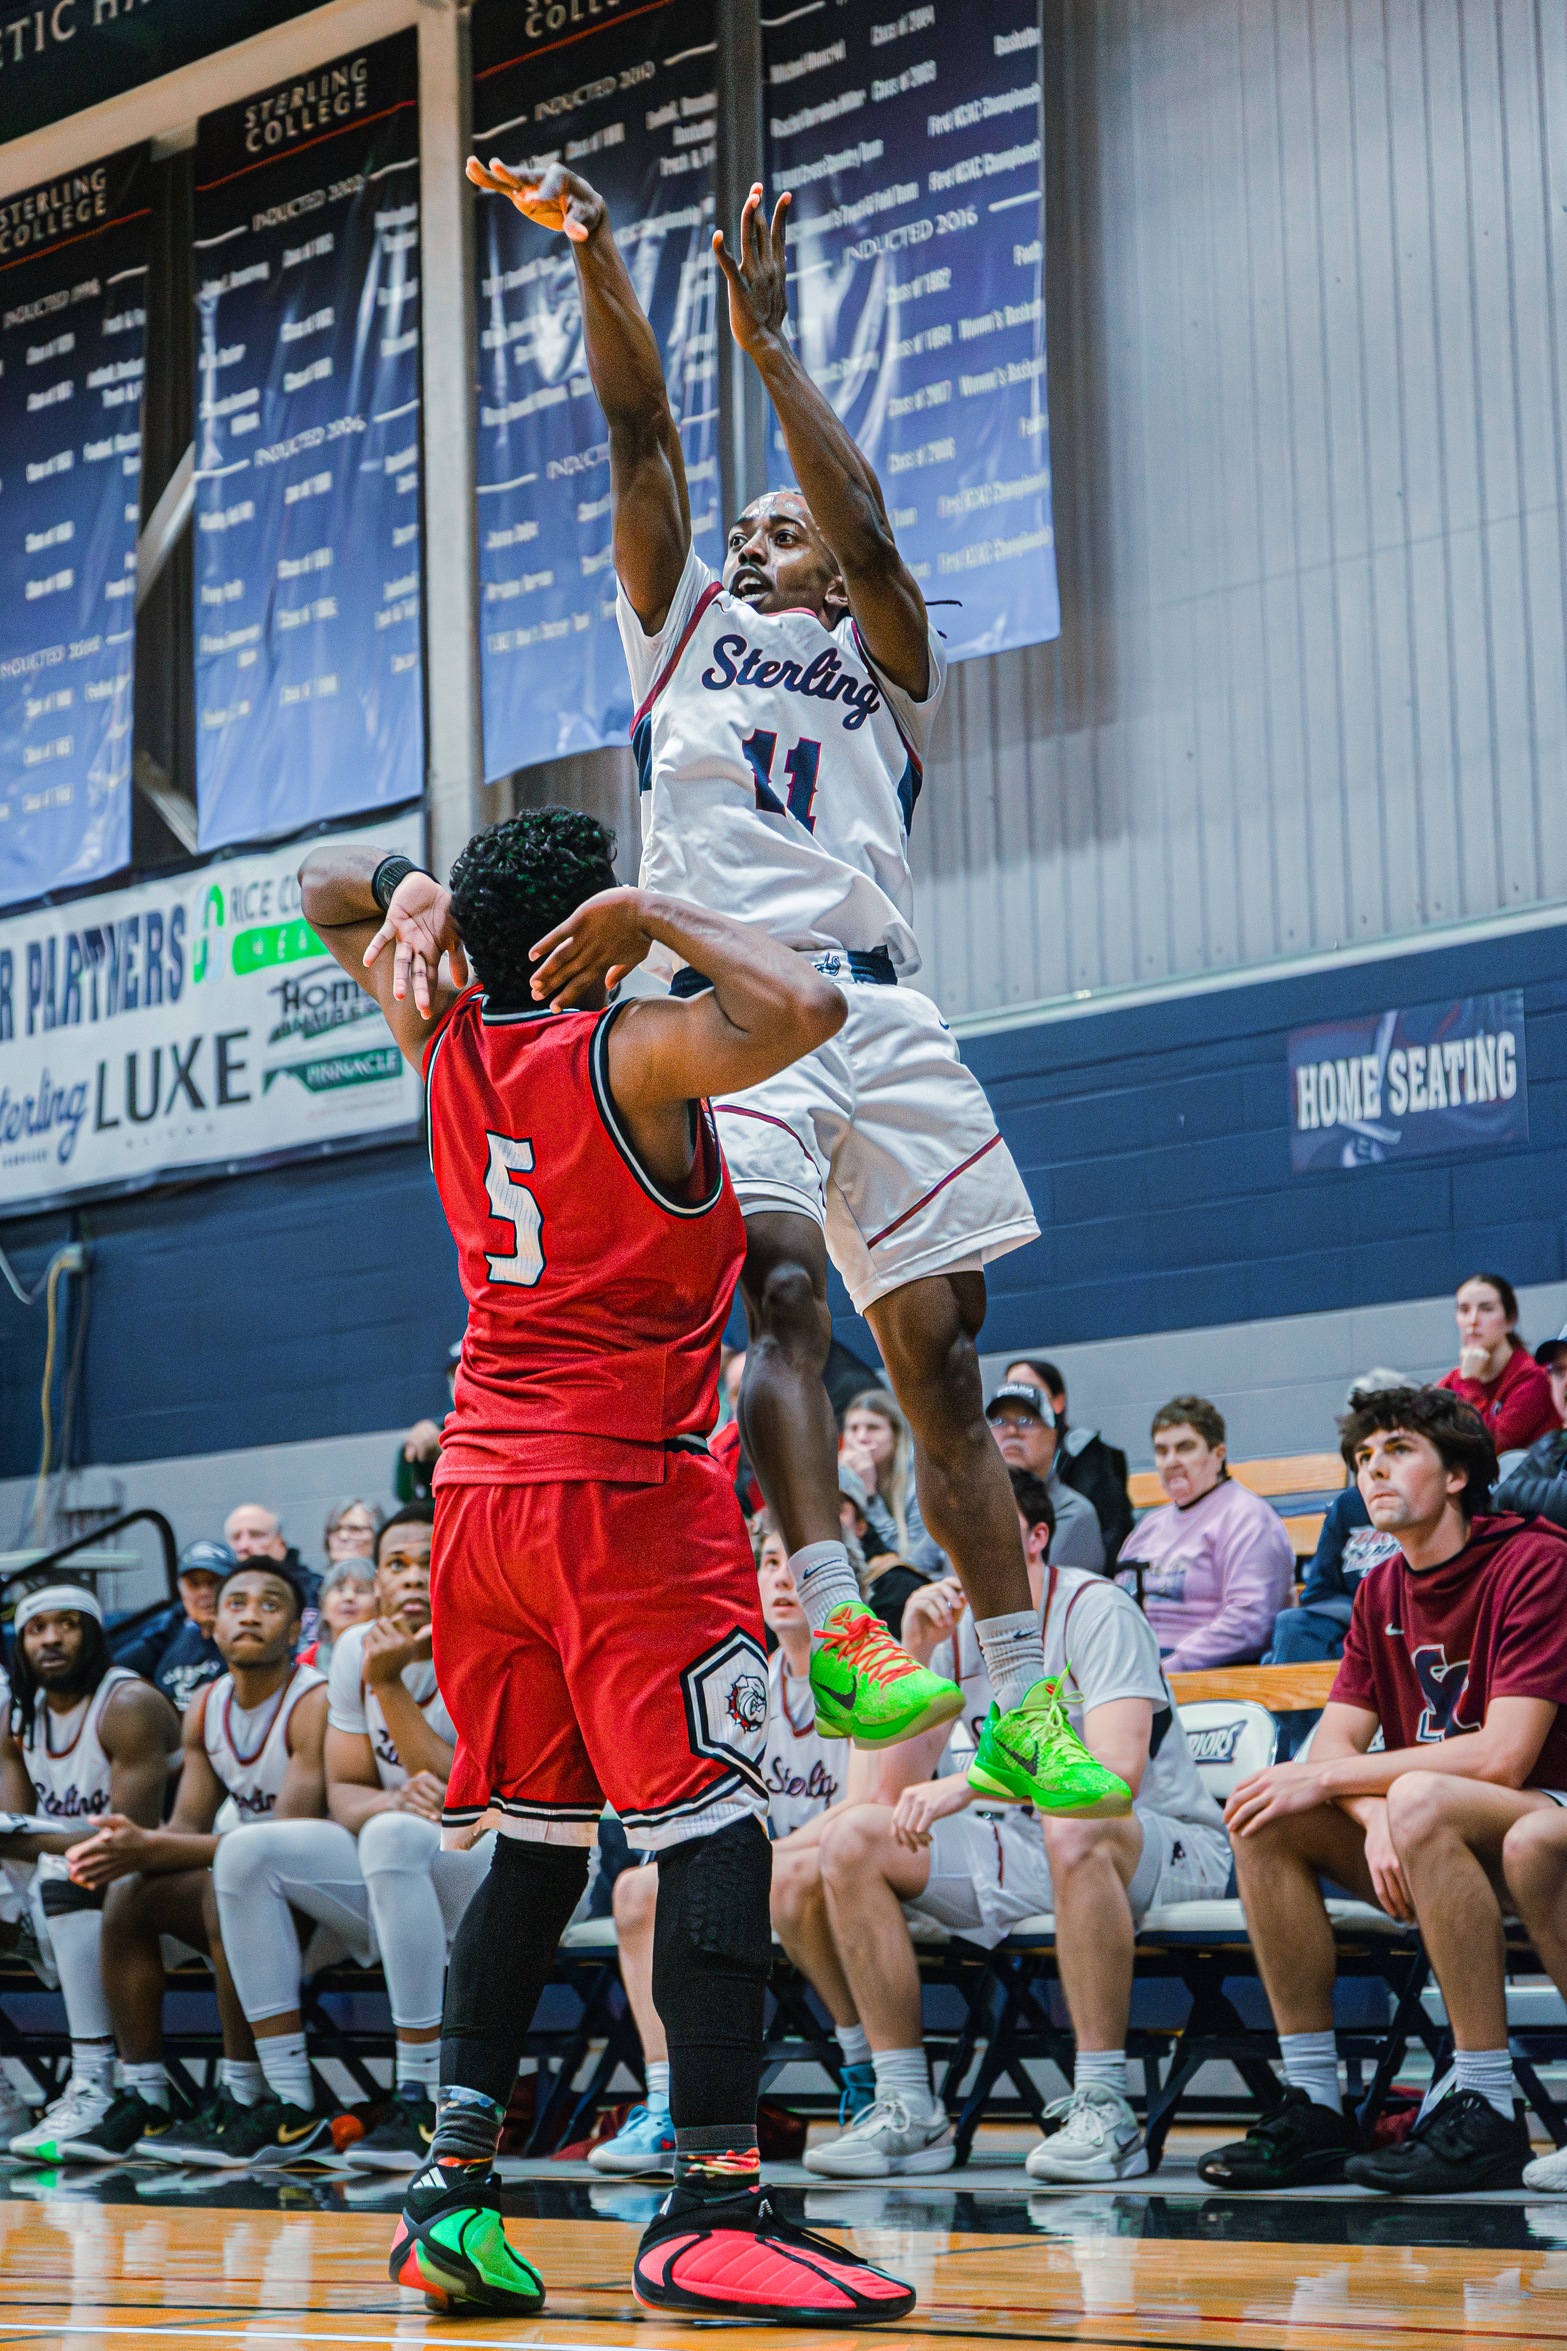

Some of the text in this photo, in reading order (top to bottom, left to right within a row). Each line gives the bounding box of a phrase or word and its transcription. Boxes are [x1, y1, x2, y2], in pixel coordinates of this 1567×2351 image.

[0, 0, 77, 69] TIC
[525, 0, 620, 38] COLL
[244, 57, 368, 130] STERLING
[245, 84, 368, 153] COLLEGE
[0, 168, 106, 233] STERLING
[0, 194, 106, 255] COLLEGE
[843, 218, 933, 261] INDUCTED
[934, 207, 979, 236] 2016
[701, 633, 880, 731] Sterling
[741, 727, 822, 837] 11
[230, 880, 273, 924] RICE
[26, 904, 186, 1036] PARTNERS
[93, 1027, 252, 1135] LUXE
[1295, 1031, 1517, 1131] HOME SEATING
[482, 1128, 547, 1289] 5
